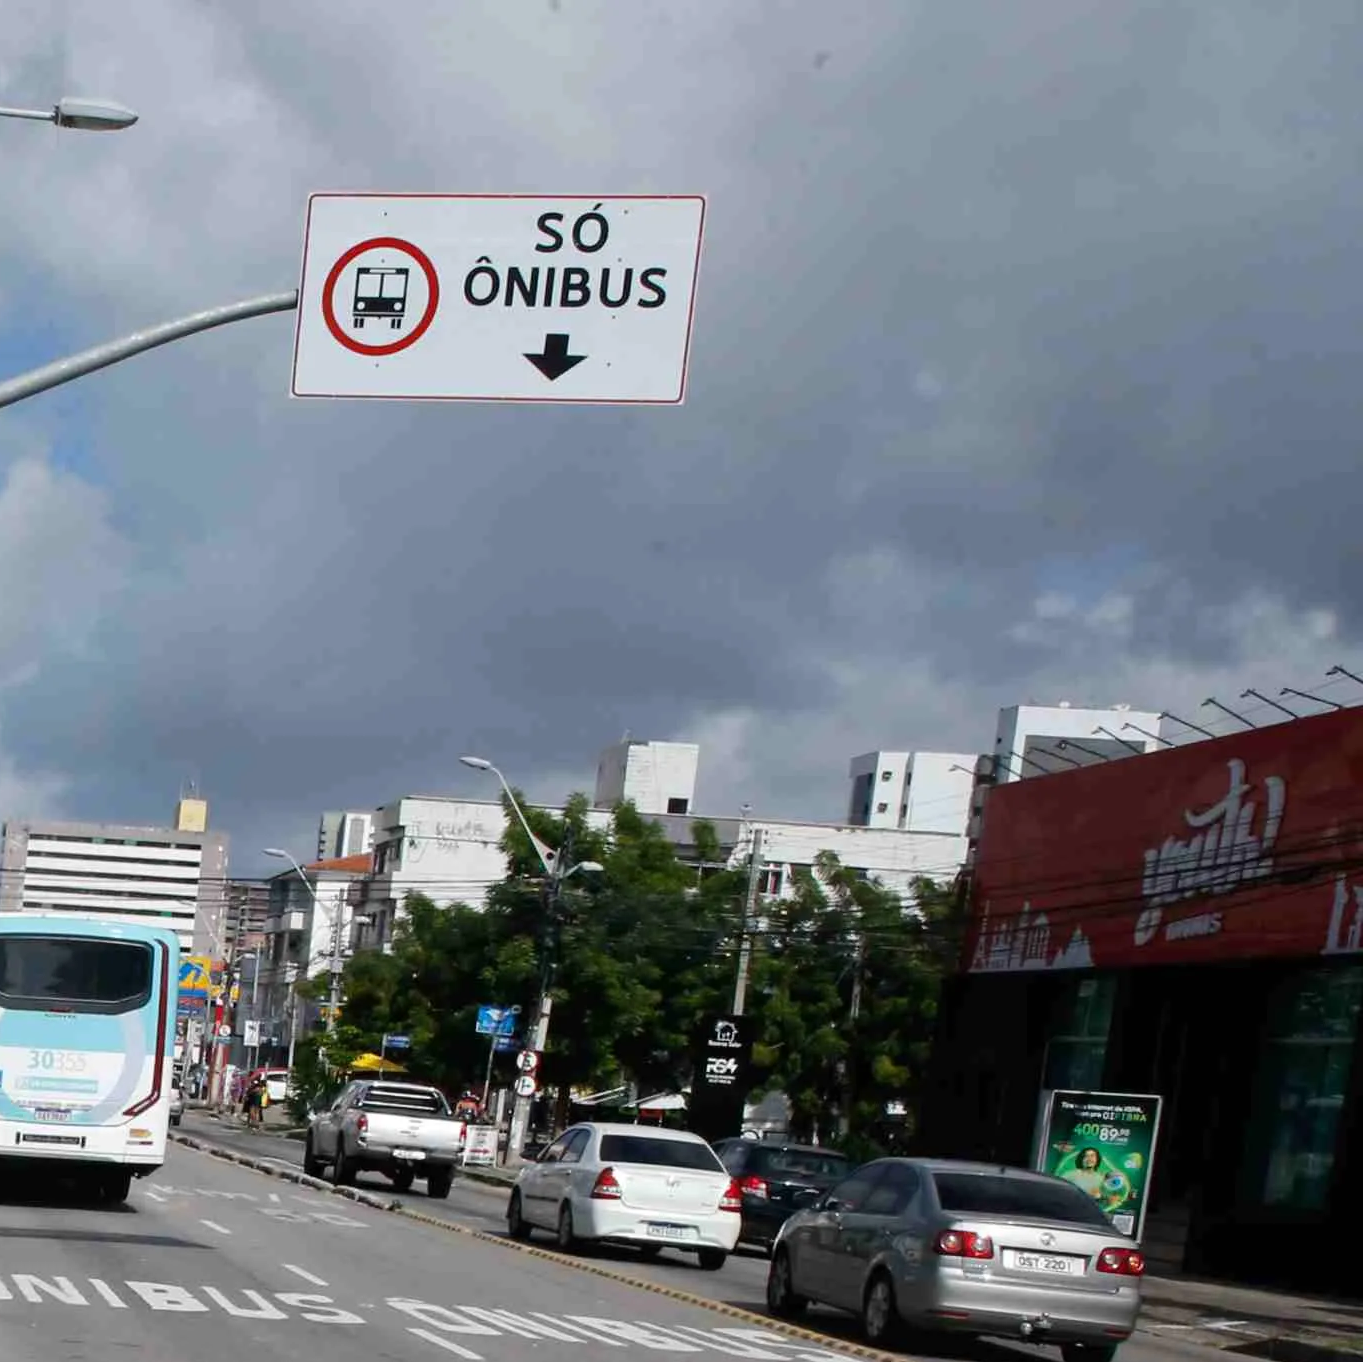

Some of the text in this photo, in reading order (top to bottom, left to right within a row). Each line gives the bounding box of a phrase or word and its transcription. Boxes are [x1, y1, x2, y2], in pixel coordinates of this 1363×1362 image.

[534, 202, 610, 254] SÓ
[463, 255, 668, 309] ÔNIBUS
[27, 1049, 87, 1072] 30355
